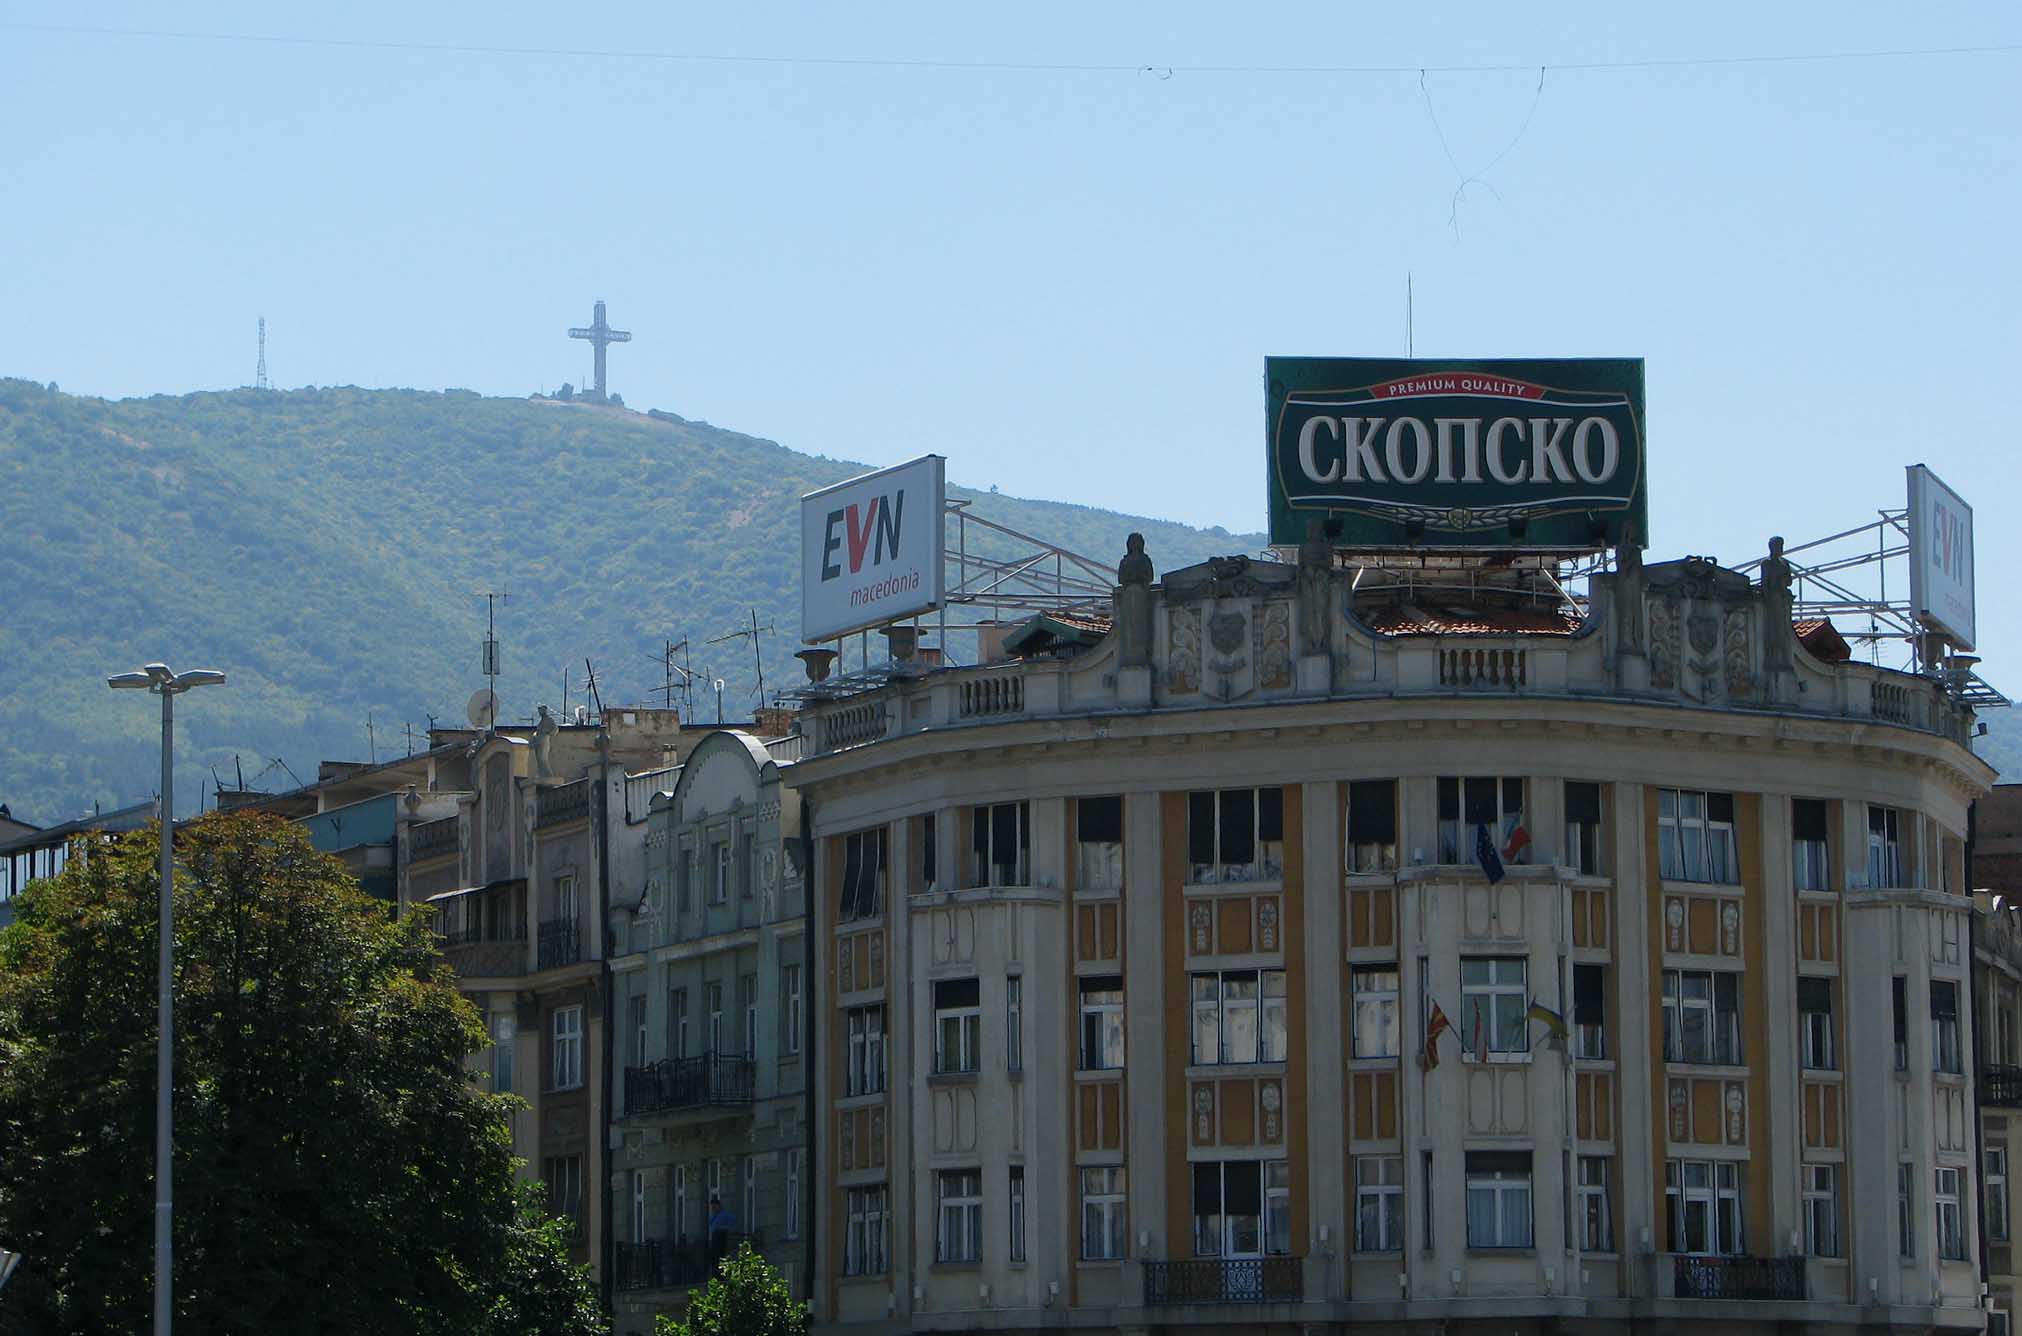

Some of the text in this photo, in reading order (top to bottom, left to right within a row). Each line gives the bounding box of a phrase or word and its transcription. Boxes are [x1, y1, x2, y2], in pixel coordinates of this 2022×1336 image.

[1389, 379, 1525, 396] PREMIUM QUALITY
[1298, 415, 1620, 485] СКОПСКО
[821, 489, 904, 582] EVN
[1933, 500, 1964, 587] EVN
[850, 567, 919, 607] macedonia
